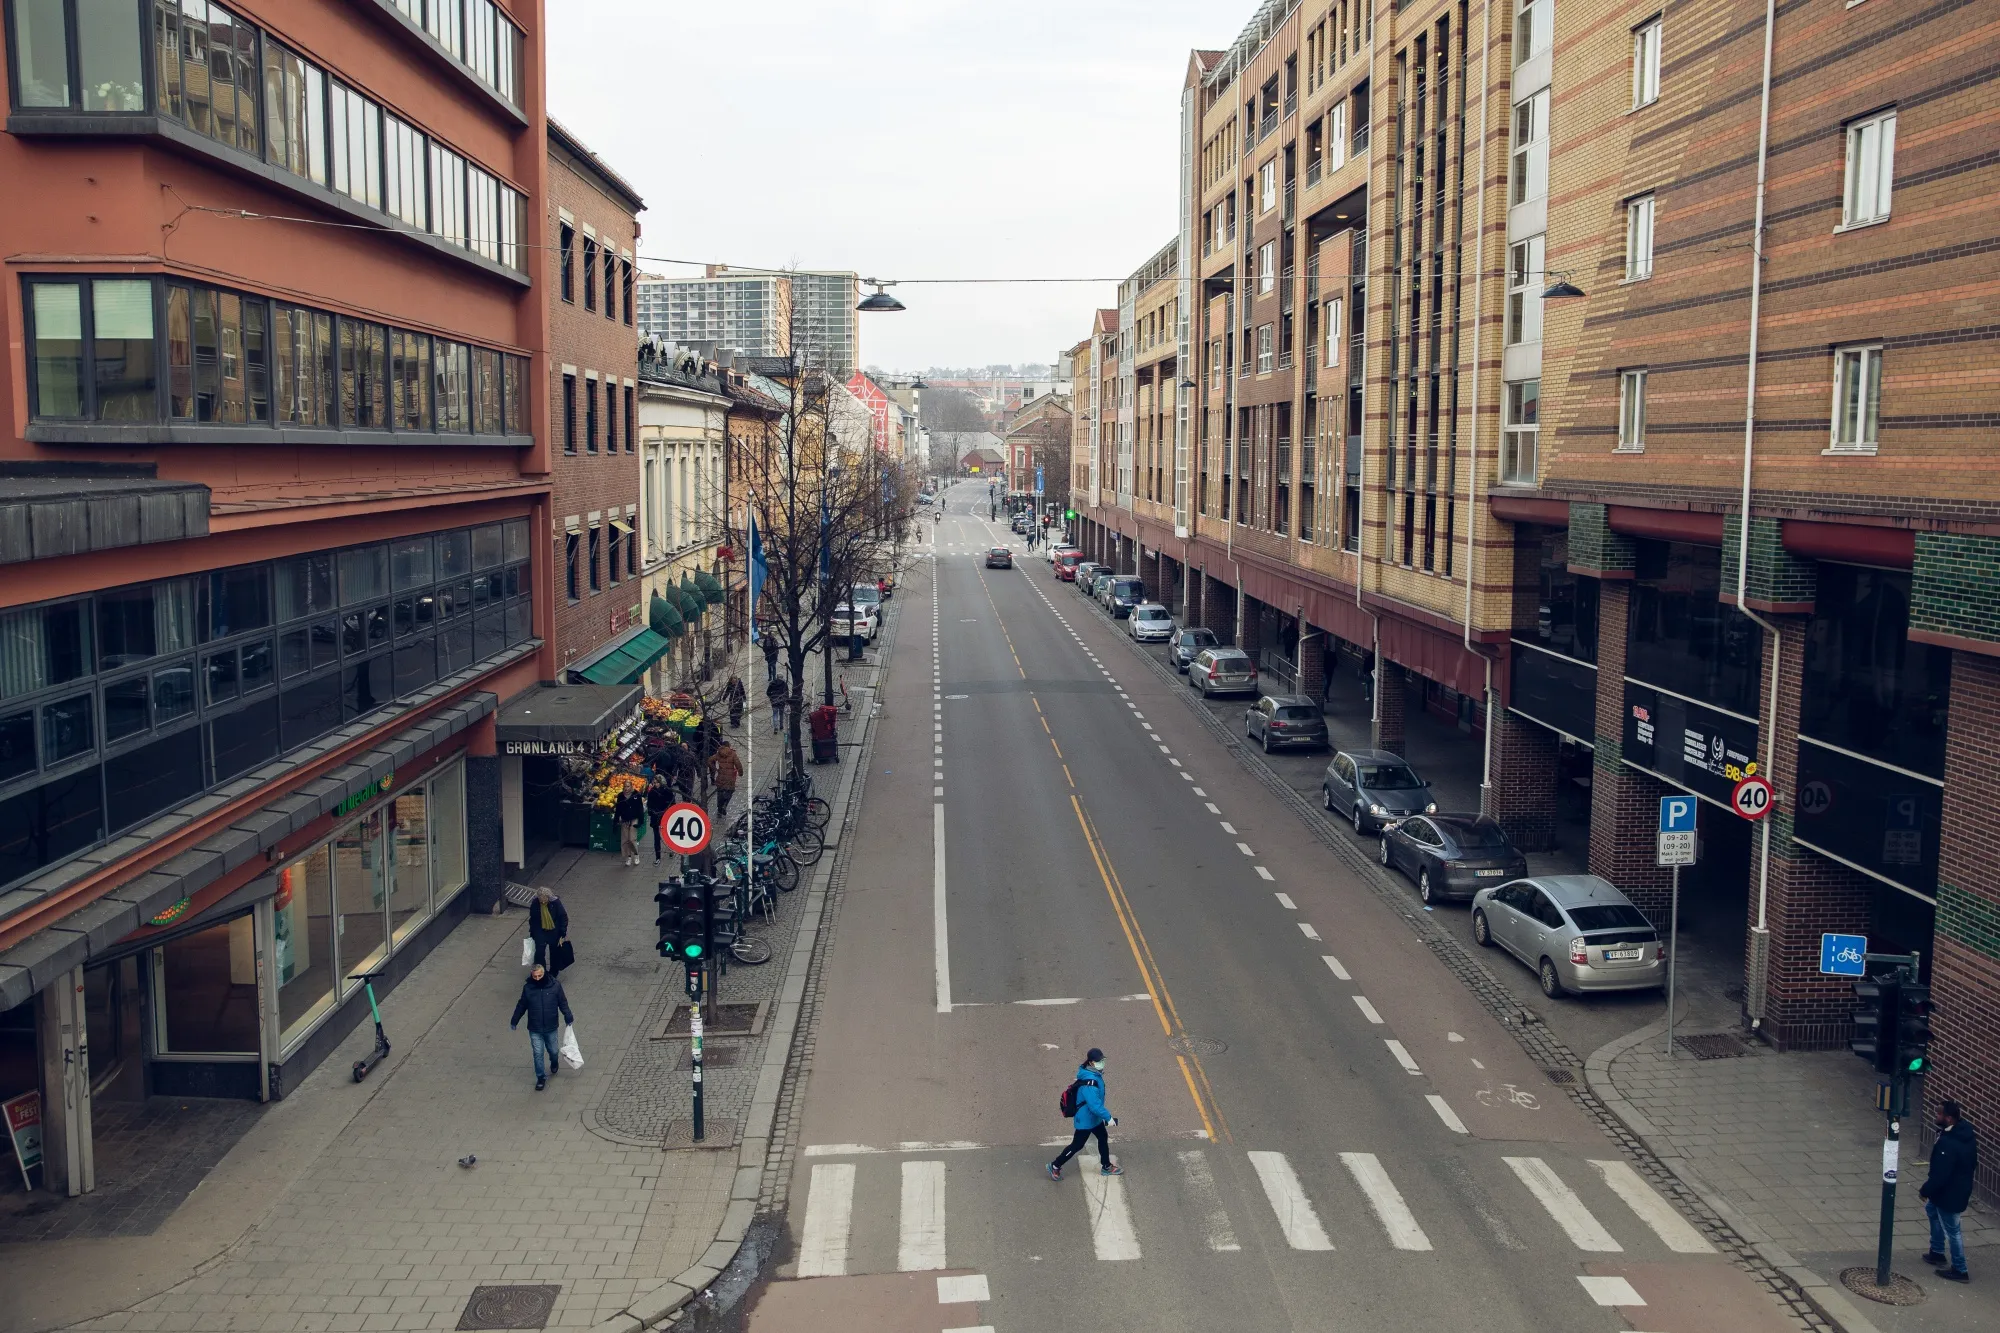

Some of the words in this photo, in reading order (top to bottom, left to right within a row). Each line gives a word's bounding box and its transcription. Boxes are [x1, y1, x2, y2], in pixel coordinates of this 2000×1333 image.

[506, 741, 574, 754] GRØNLAND
[1739, 788, 1768, 809] 40
[1668, 801, 1688, 828] P
[669, 817, 703, 842] 40
